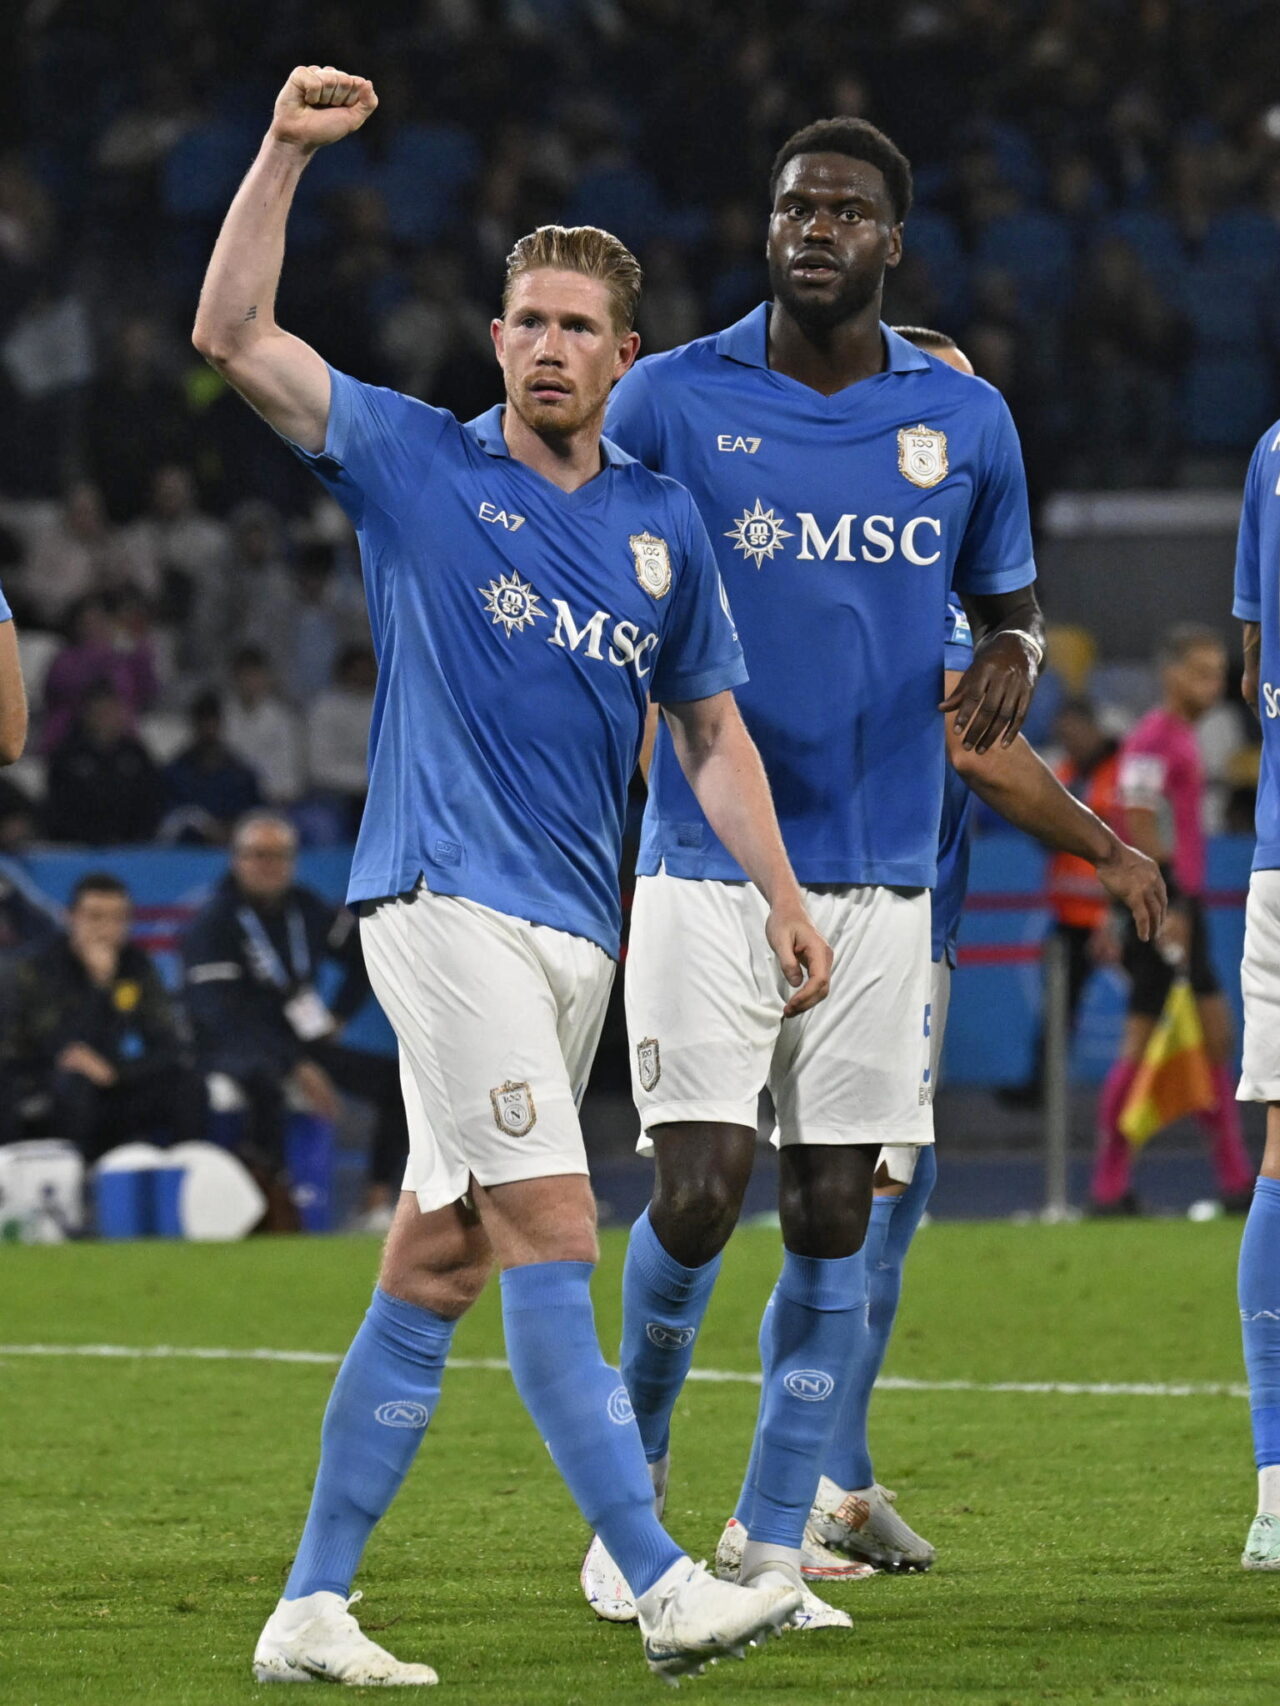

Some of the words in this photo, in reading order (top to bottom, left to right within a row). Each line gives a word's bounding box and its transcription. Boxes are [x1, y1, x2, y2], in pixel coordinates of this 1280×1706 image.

[716, 434, 762, 454] EA7
[478, 501, 526, 532] EA7
[796, 512, 941, 566] MSC
[548, 598, 659, 678] MSC
